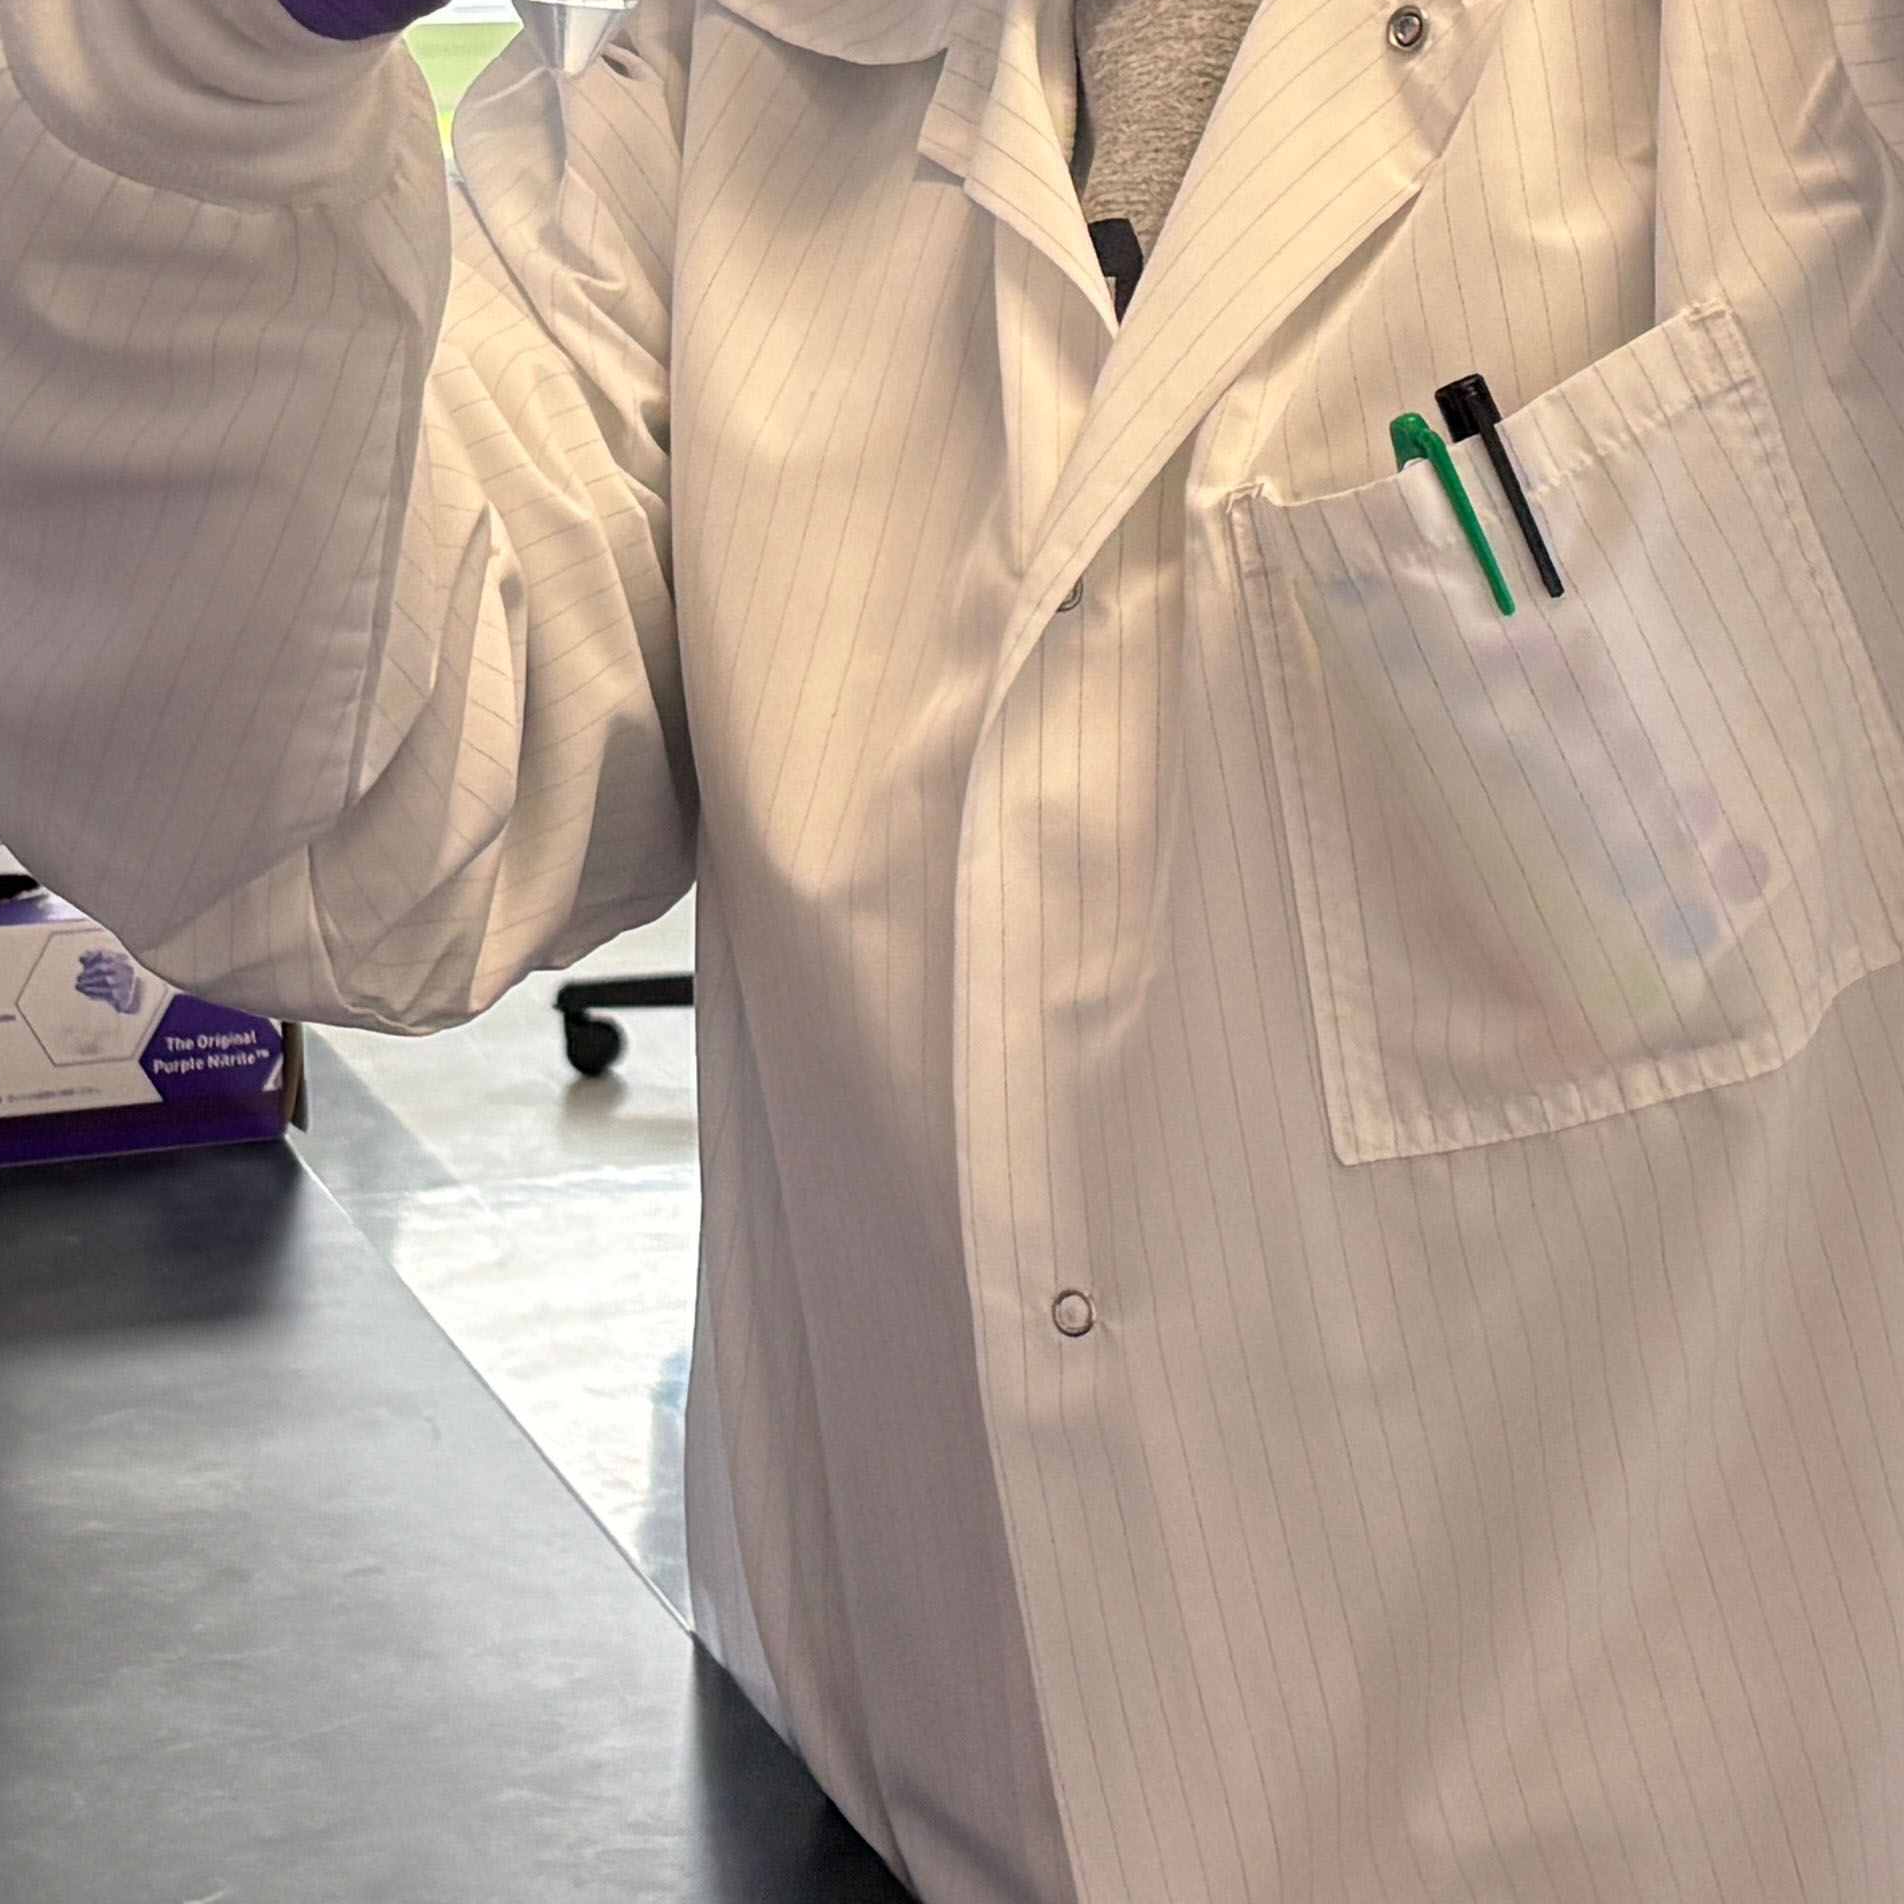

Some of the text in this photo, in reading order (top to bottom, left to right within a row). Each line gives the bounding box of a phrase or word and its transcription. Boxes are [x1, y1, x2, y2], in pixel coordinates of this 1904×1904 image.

[166, 1029, 257, 1052] The Original
[153, 1056, 205, 1075] Purple
